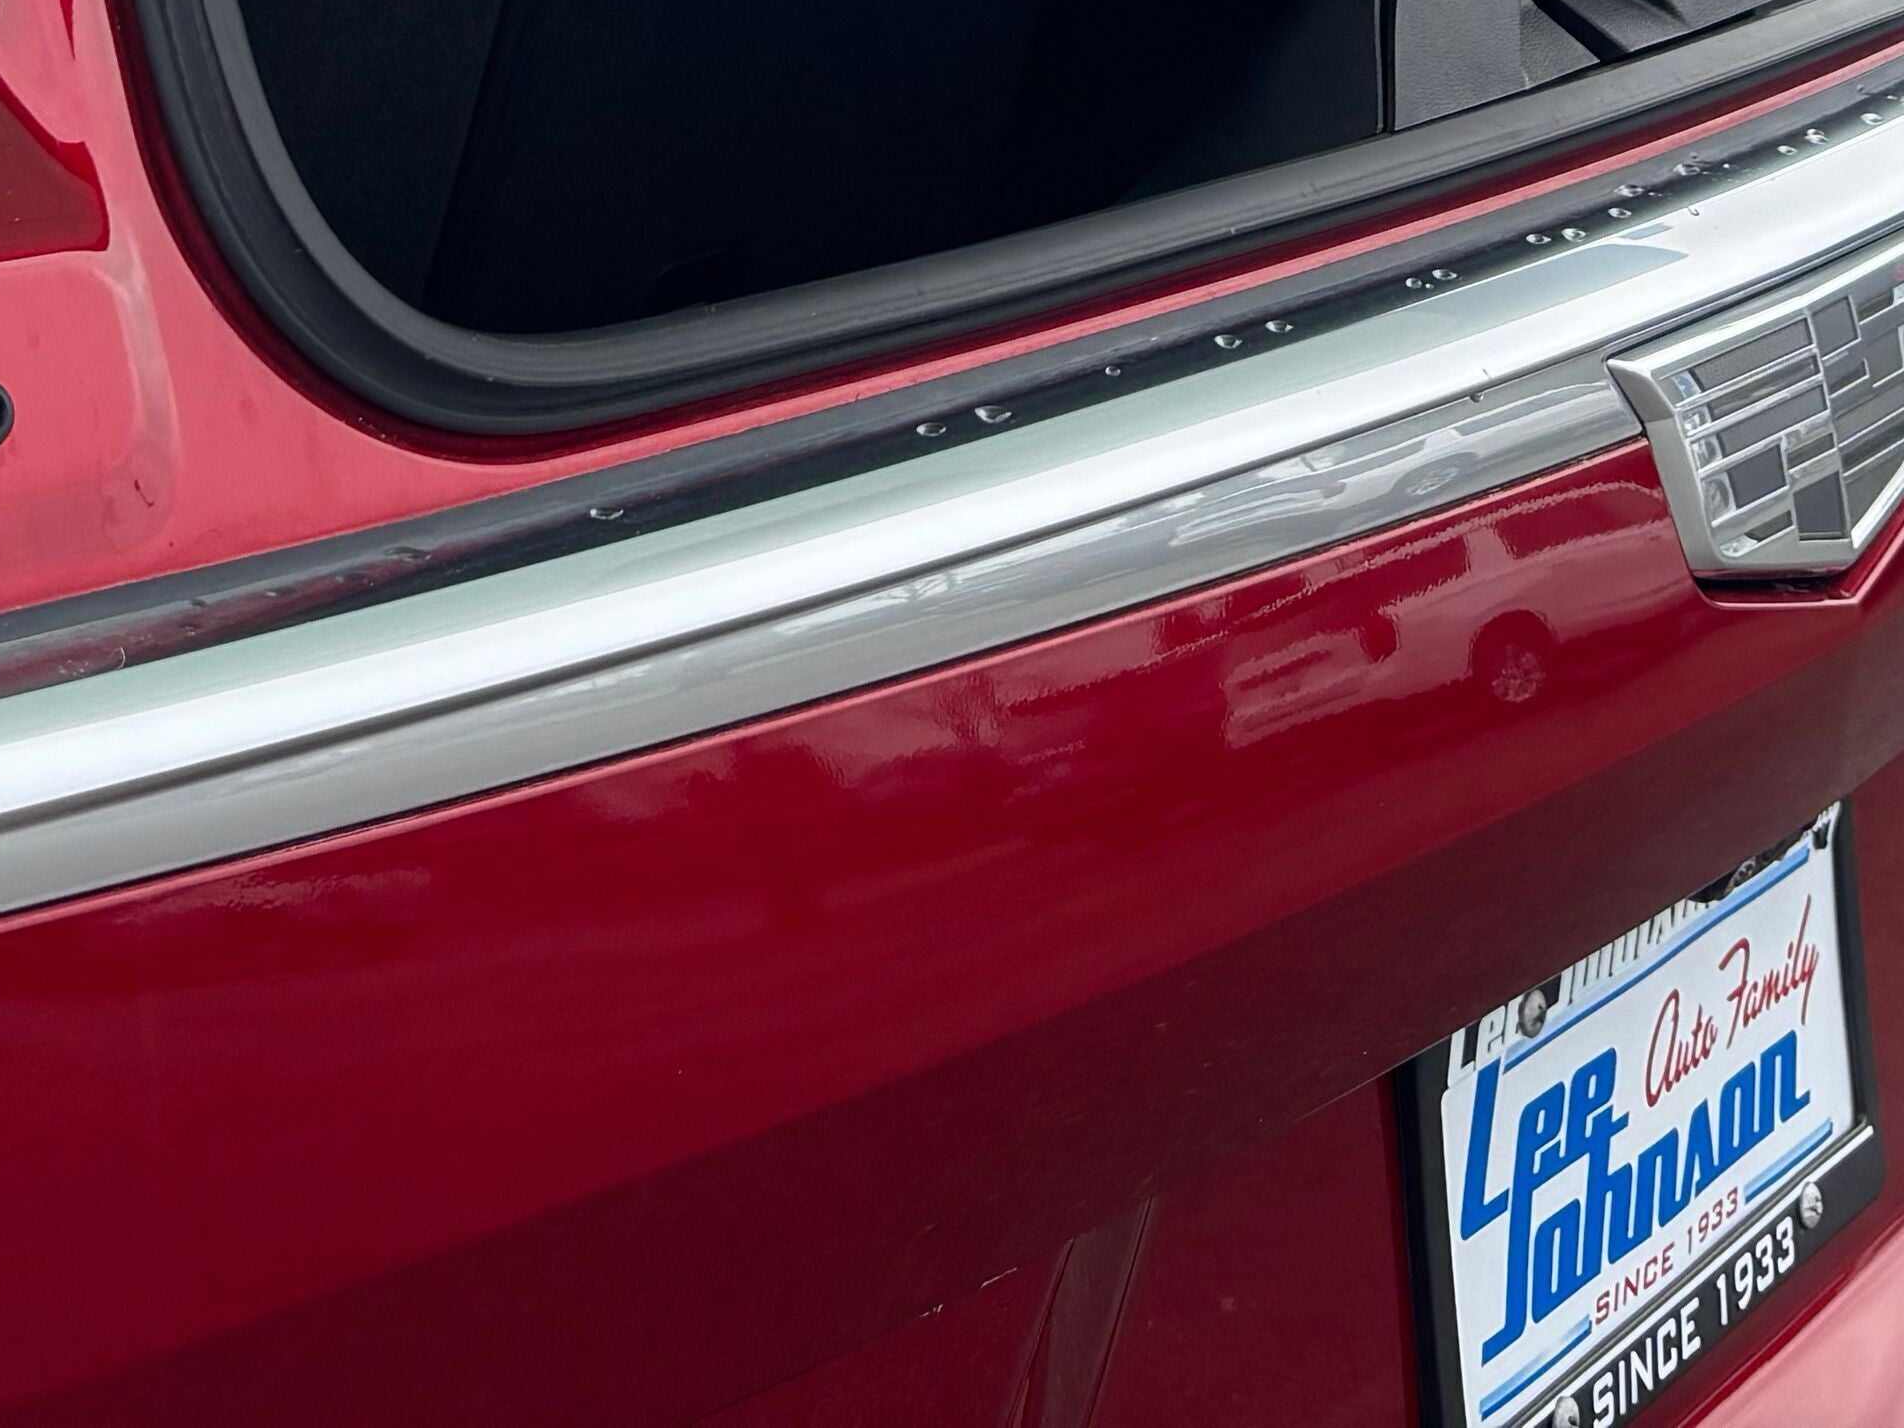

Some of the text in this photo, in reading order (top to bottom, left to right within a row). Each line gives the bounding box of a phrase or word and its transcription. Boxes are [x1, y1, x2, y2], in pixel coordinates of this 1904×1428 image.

[1460, 1047, 1631, 1242] Lee
[1645, 988, 1719, 1107] Auto
[1718, 893, 1819, 1049] Family
[1481, 1028, 1812, 1368] Johnson
[1592, 1215, 1796, 1428] SINCE 1933
[1594, 1186, 1739, 1326] SINCE 1933
